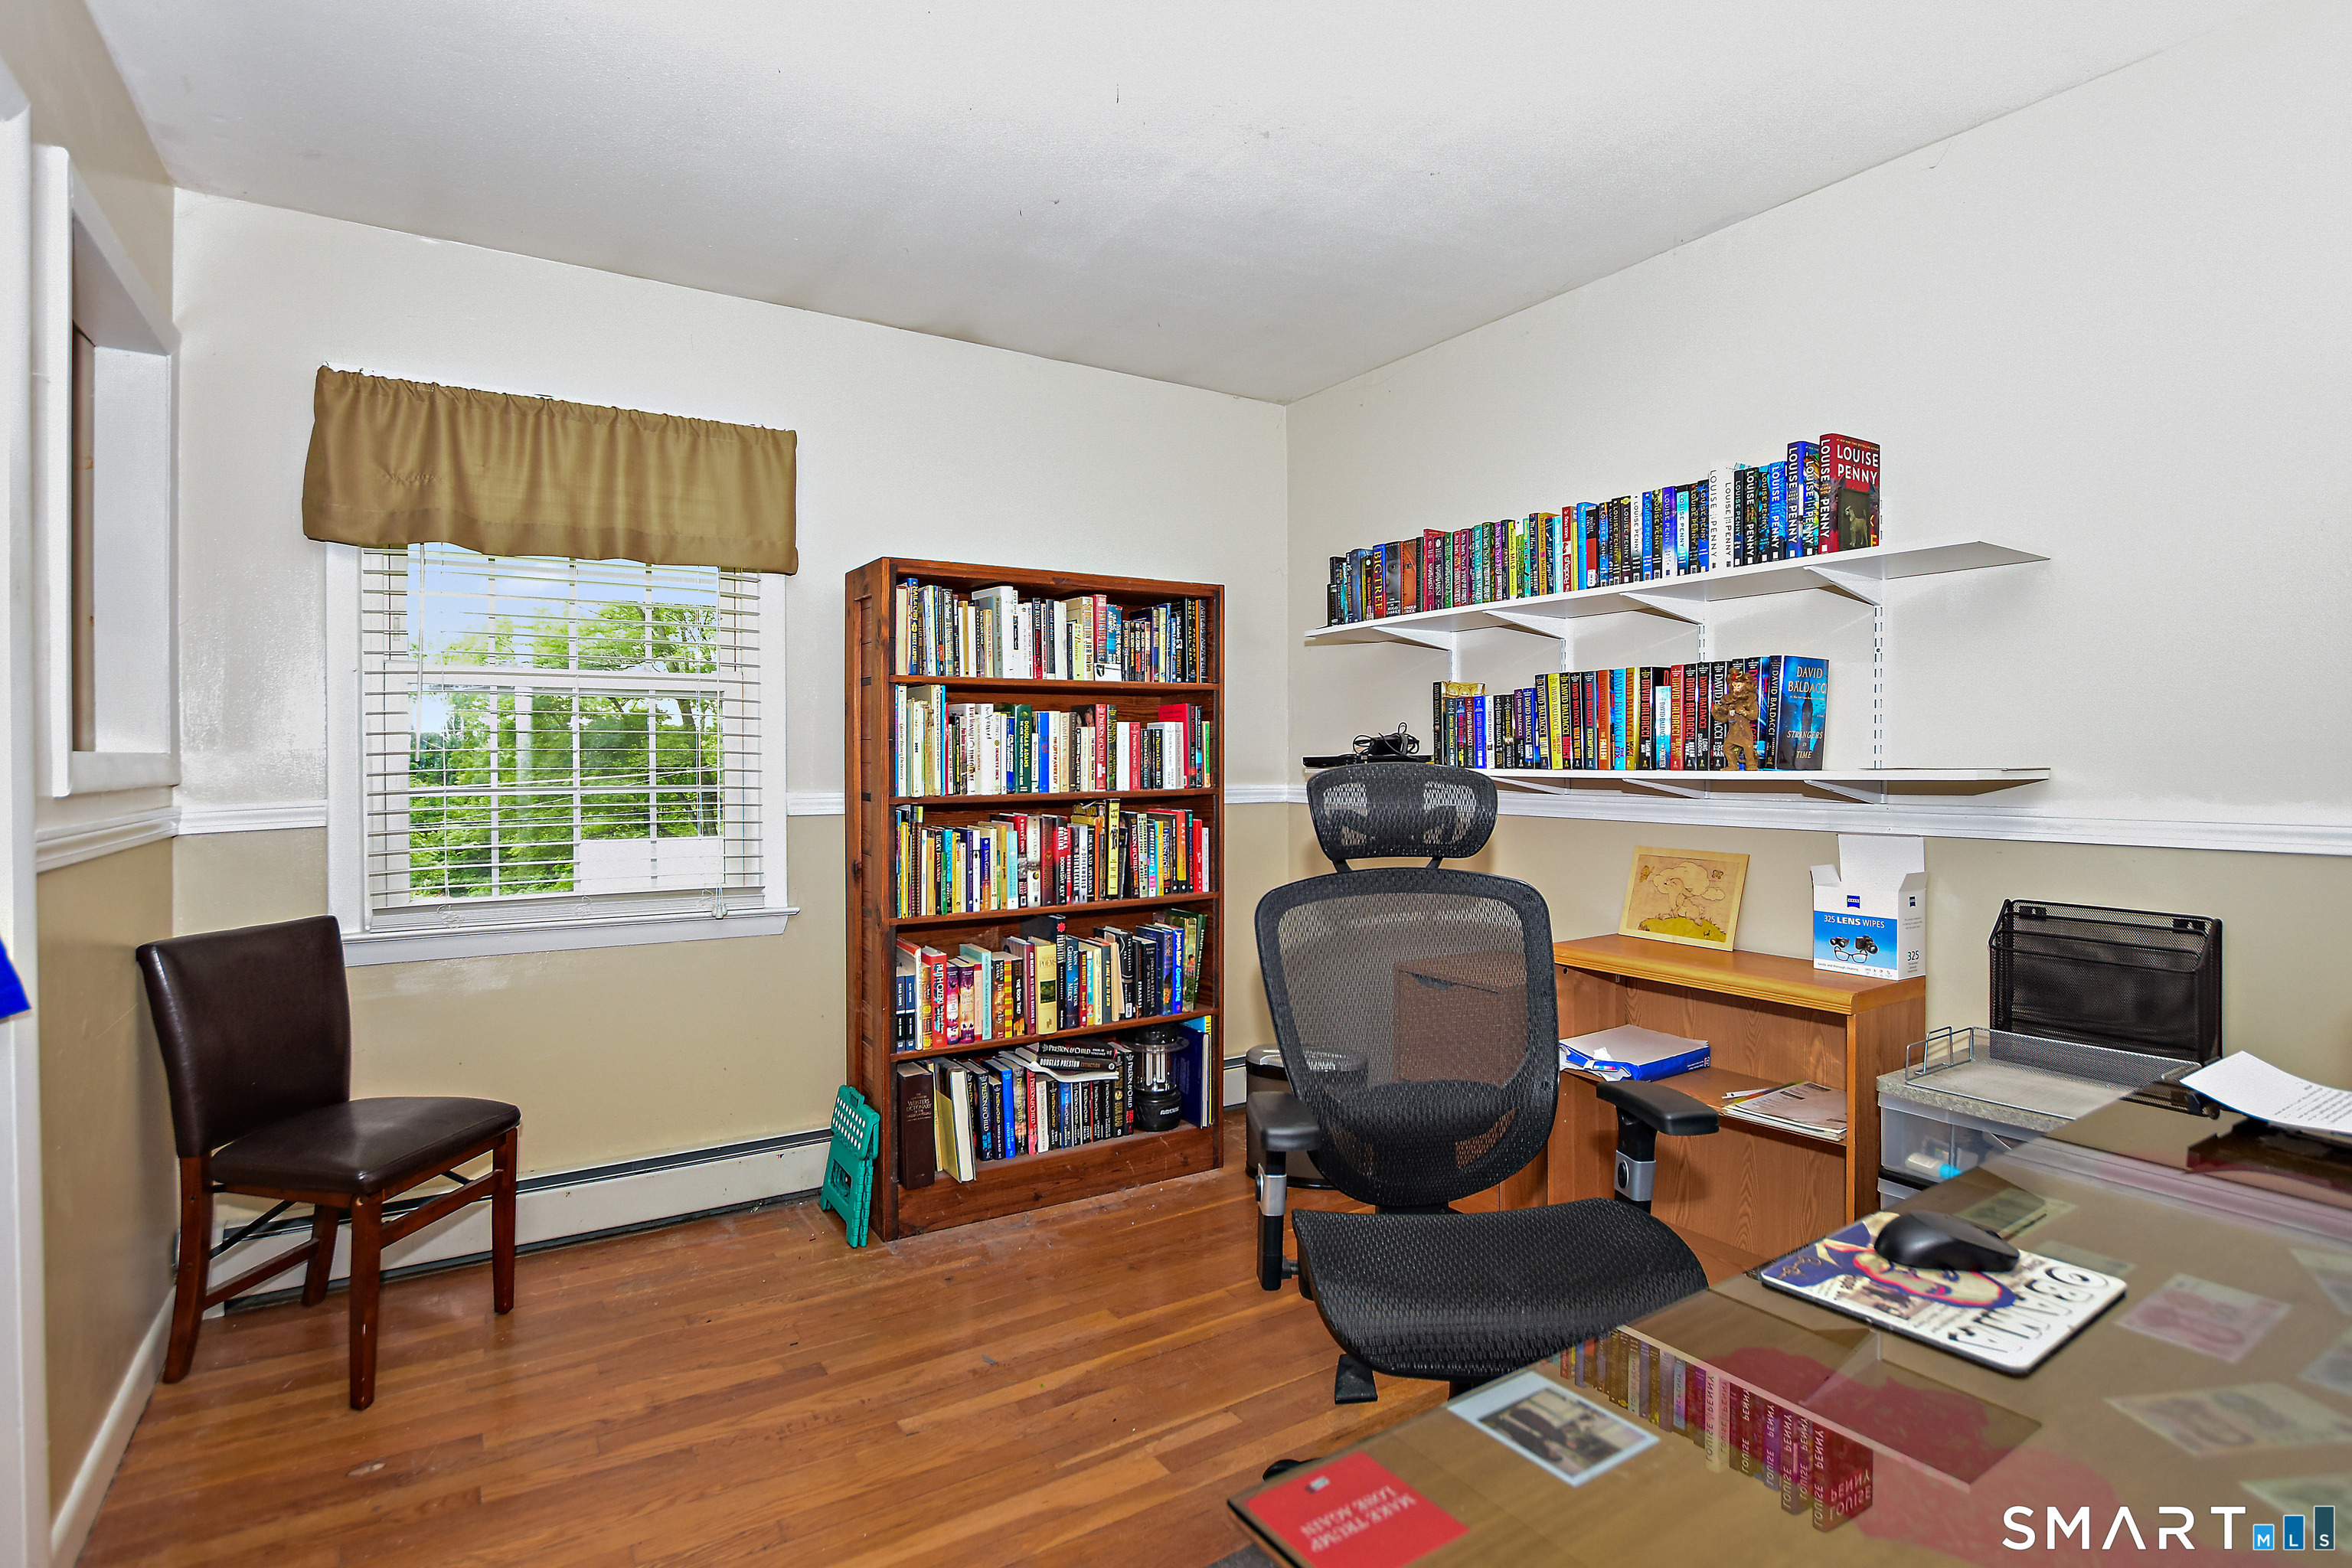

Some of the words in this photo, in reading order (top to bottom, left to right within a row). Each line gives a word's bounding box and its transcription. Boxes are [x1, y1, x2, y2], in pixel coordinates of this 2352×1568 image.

[1788, 447, 1798, 489] LOUISE
[1821, 439, 1831, 482] LOUISE
[1838, 444, 1879, 468] LOUISE
[1772, 466, 1780, 502] LOUISE
[1805, 461, 1814, 497] LOUISE
[1838, 464, 1877, 485] PENNY
[1771, 515, 1780, 548] PENNY
[1788, 505, 1798, 543] PENNY
[1805, 510, 1814, 544] PENNY
[1820, 498, 1830, 538] PENNY
[1374, 550, 1383, 573] BIG
[1374, 573, 1383, 610] TREE
[1083, 604, 1093, 639] SILMARILLION
[1715, 674, 1723, 698] DAVID
[1796, 666, 1823, 678] DAVID
[1642, 679, 1650, 701] DAVID
[1686, 678, 1694, 701] DAVID
[1642, 703, 1650, 737] BALDACCI
[1686, 702, 1694, 740] BALDACCI
[1769, 697, 1777, 735] BALDACCI
[1787, 730, 1823, 739] STRANGERS
[1796, 750, 1812, 759] TIME
[1824, 914, 1835, 923] 325
[1837, 916, 1861, 926] LENS
[1862, 919, 1885, 929] WIPES
[1907, 950, 1919, 962] 325
[1049, 1044, 1069, 1053] PRESTON
